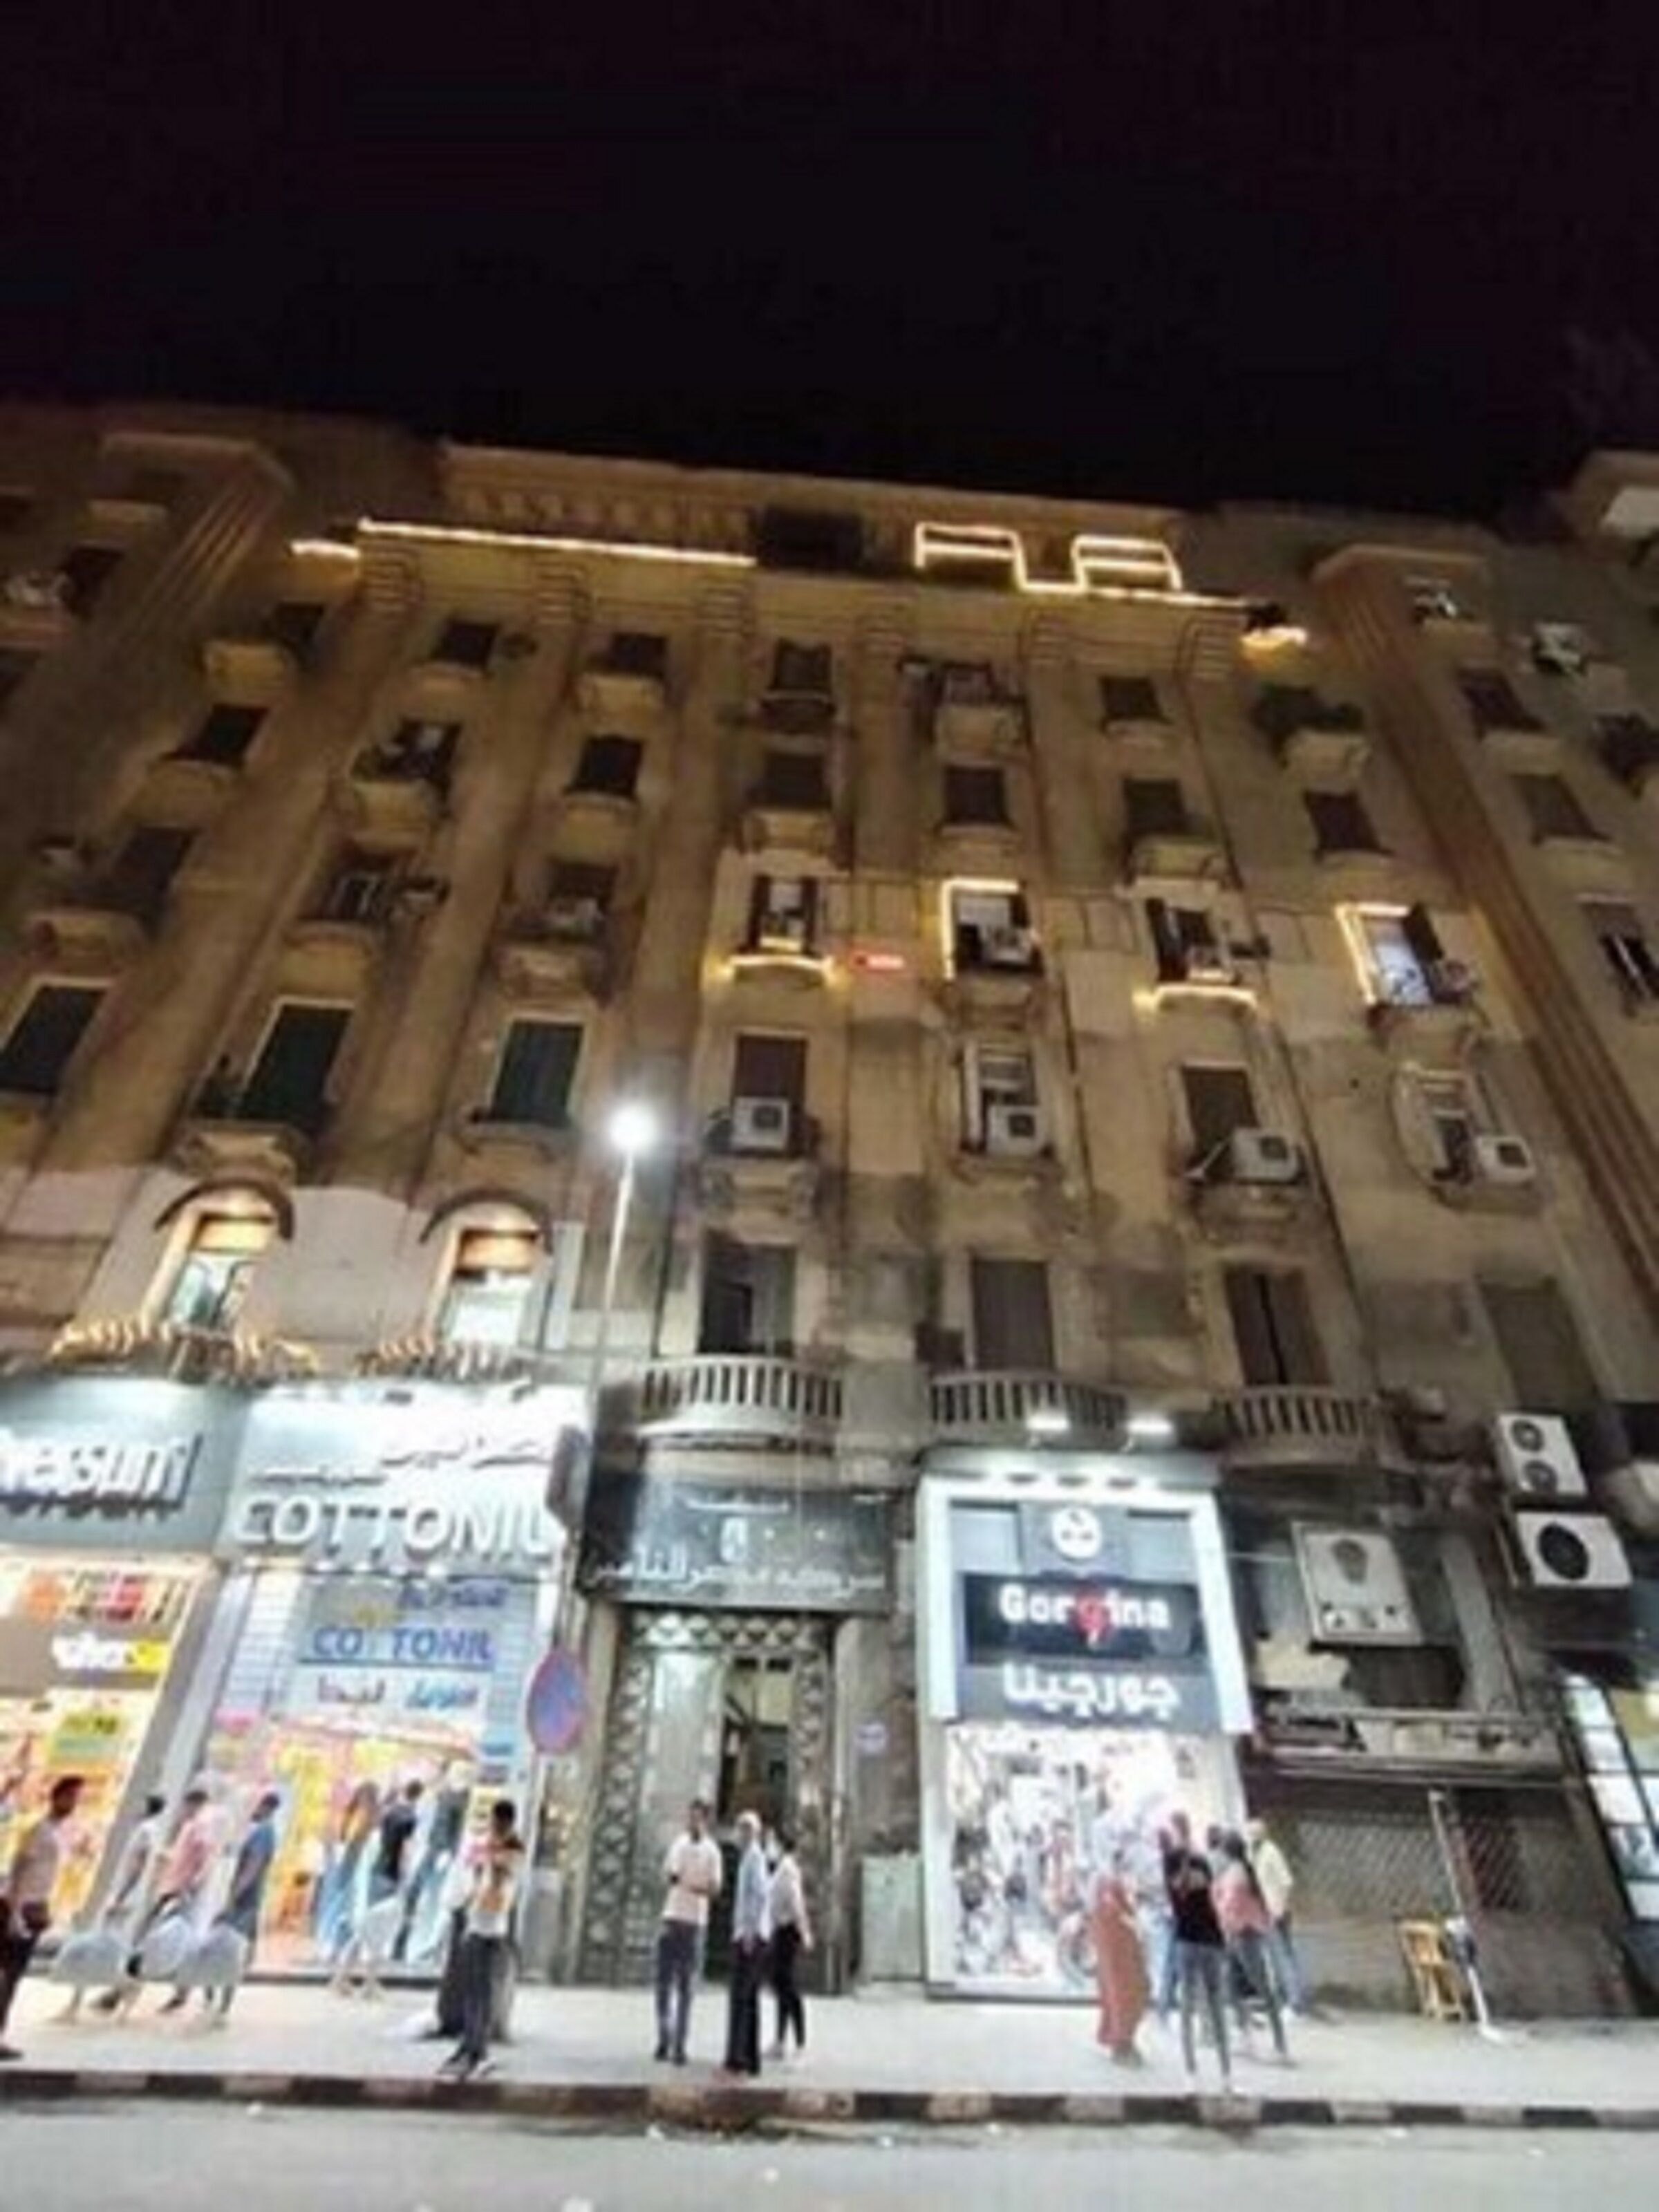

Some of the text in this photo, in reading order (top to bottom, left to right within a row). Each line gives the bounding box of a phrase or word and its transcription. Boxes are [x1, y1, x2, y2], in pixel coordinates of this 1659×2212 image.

[234, 1493, 557, 1555] COTTONIL
[312, 1624, 494, 1660] COTONIL
[999, 1583, 1170, 1642] Gorgina
